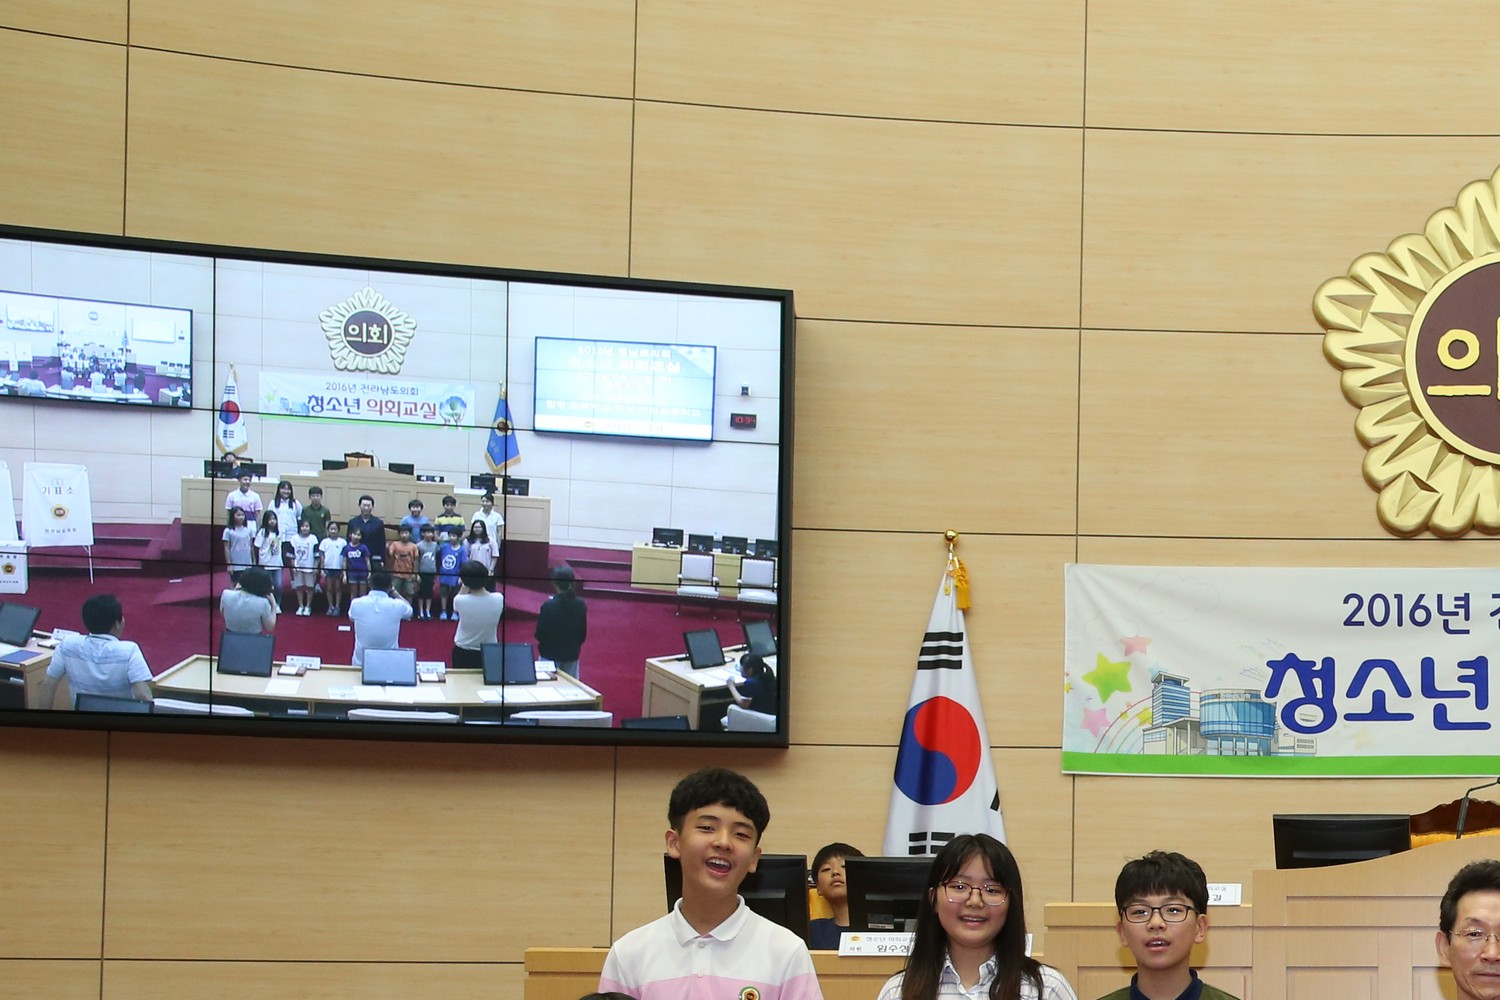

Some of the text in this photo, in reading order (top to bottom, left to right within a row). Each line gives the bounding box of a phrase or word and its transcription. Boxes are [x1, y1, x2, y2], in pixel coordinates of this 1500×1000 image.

[346, 322, 388, 344] 의회
[307, 394, 437, 420] 청소년 의회교실
[1343, 592, 1472, 635] 2016년
[1266, 652, 1492, 735] 청소년
